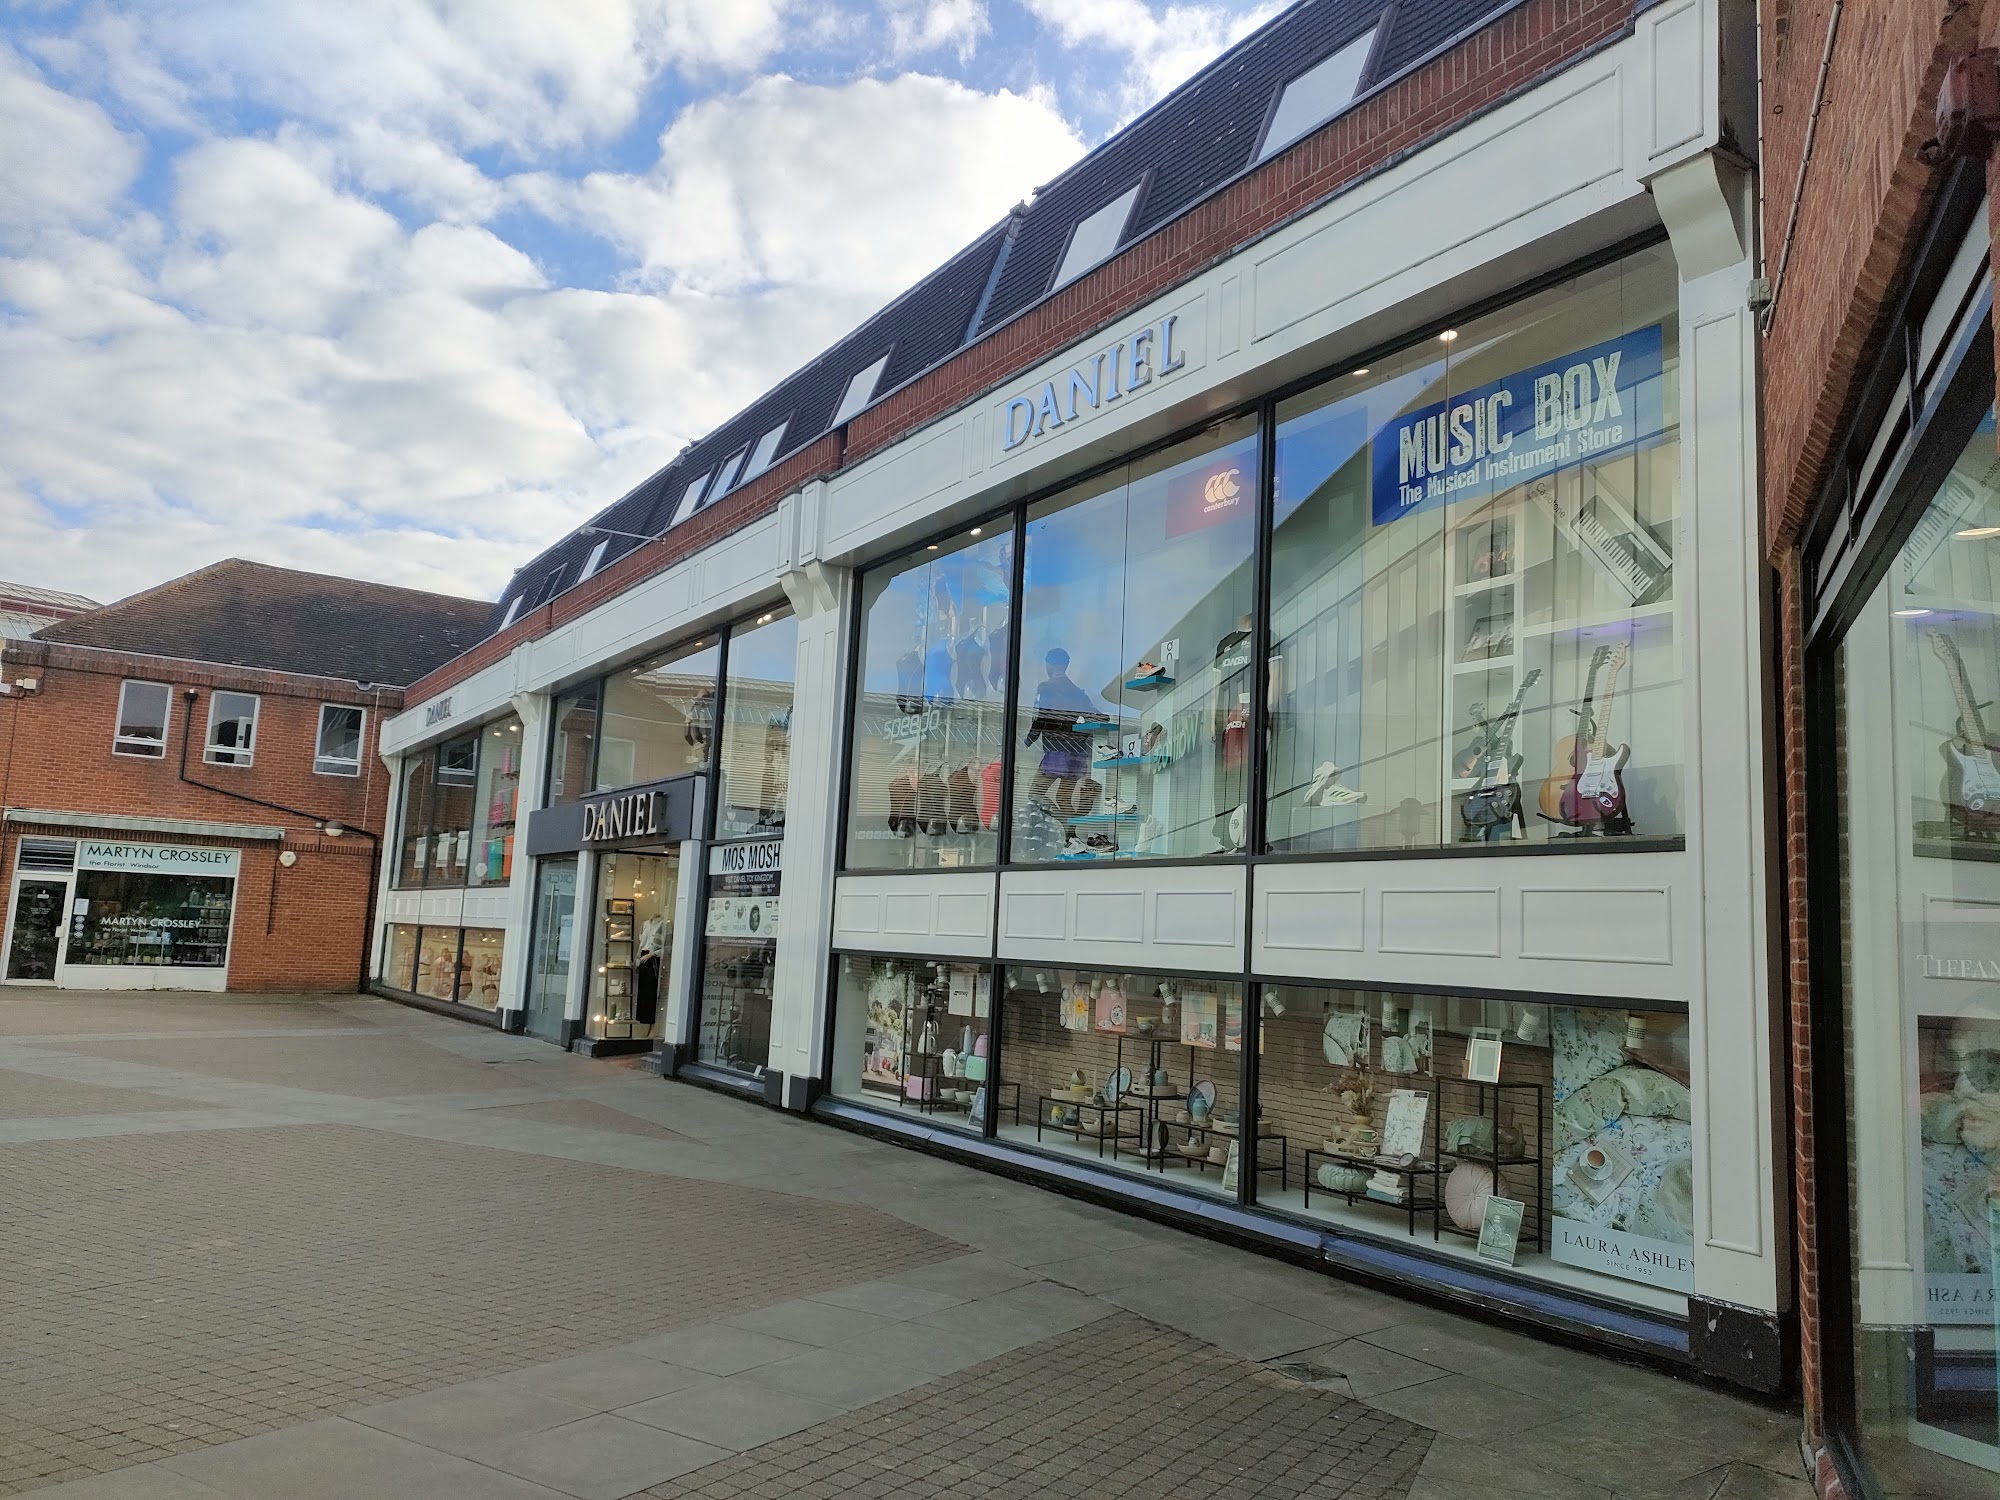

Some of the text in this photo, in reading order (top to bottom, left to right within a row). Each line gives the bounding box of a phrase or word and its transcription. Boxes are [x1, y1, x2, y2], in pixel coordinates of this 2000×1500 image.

[1003, 315, 1185, 451] DANIEL
[1399, 351, 1623, 484] MUSIC BOX
[1399, 424, 1623, 507] The Musical Instrument Store
[1203, 497, 1240, 513] canterbury
[1536, 482, 1566, 519] Casiotone
[882, 705, 940, 745] speedo
[581, 791, 662, 842] DANIEL
[87, 844, 232, 864] MARTYN CROSSLEY
[721, 843, 781, 872] MOS MOSH
[100, 917, 202, 928] MARTYN CROSSLEY
[1564, 1231, 1621, 1257] LAURA
[1606, 1260, 1653, 1276] SINCE 1953
